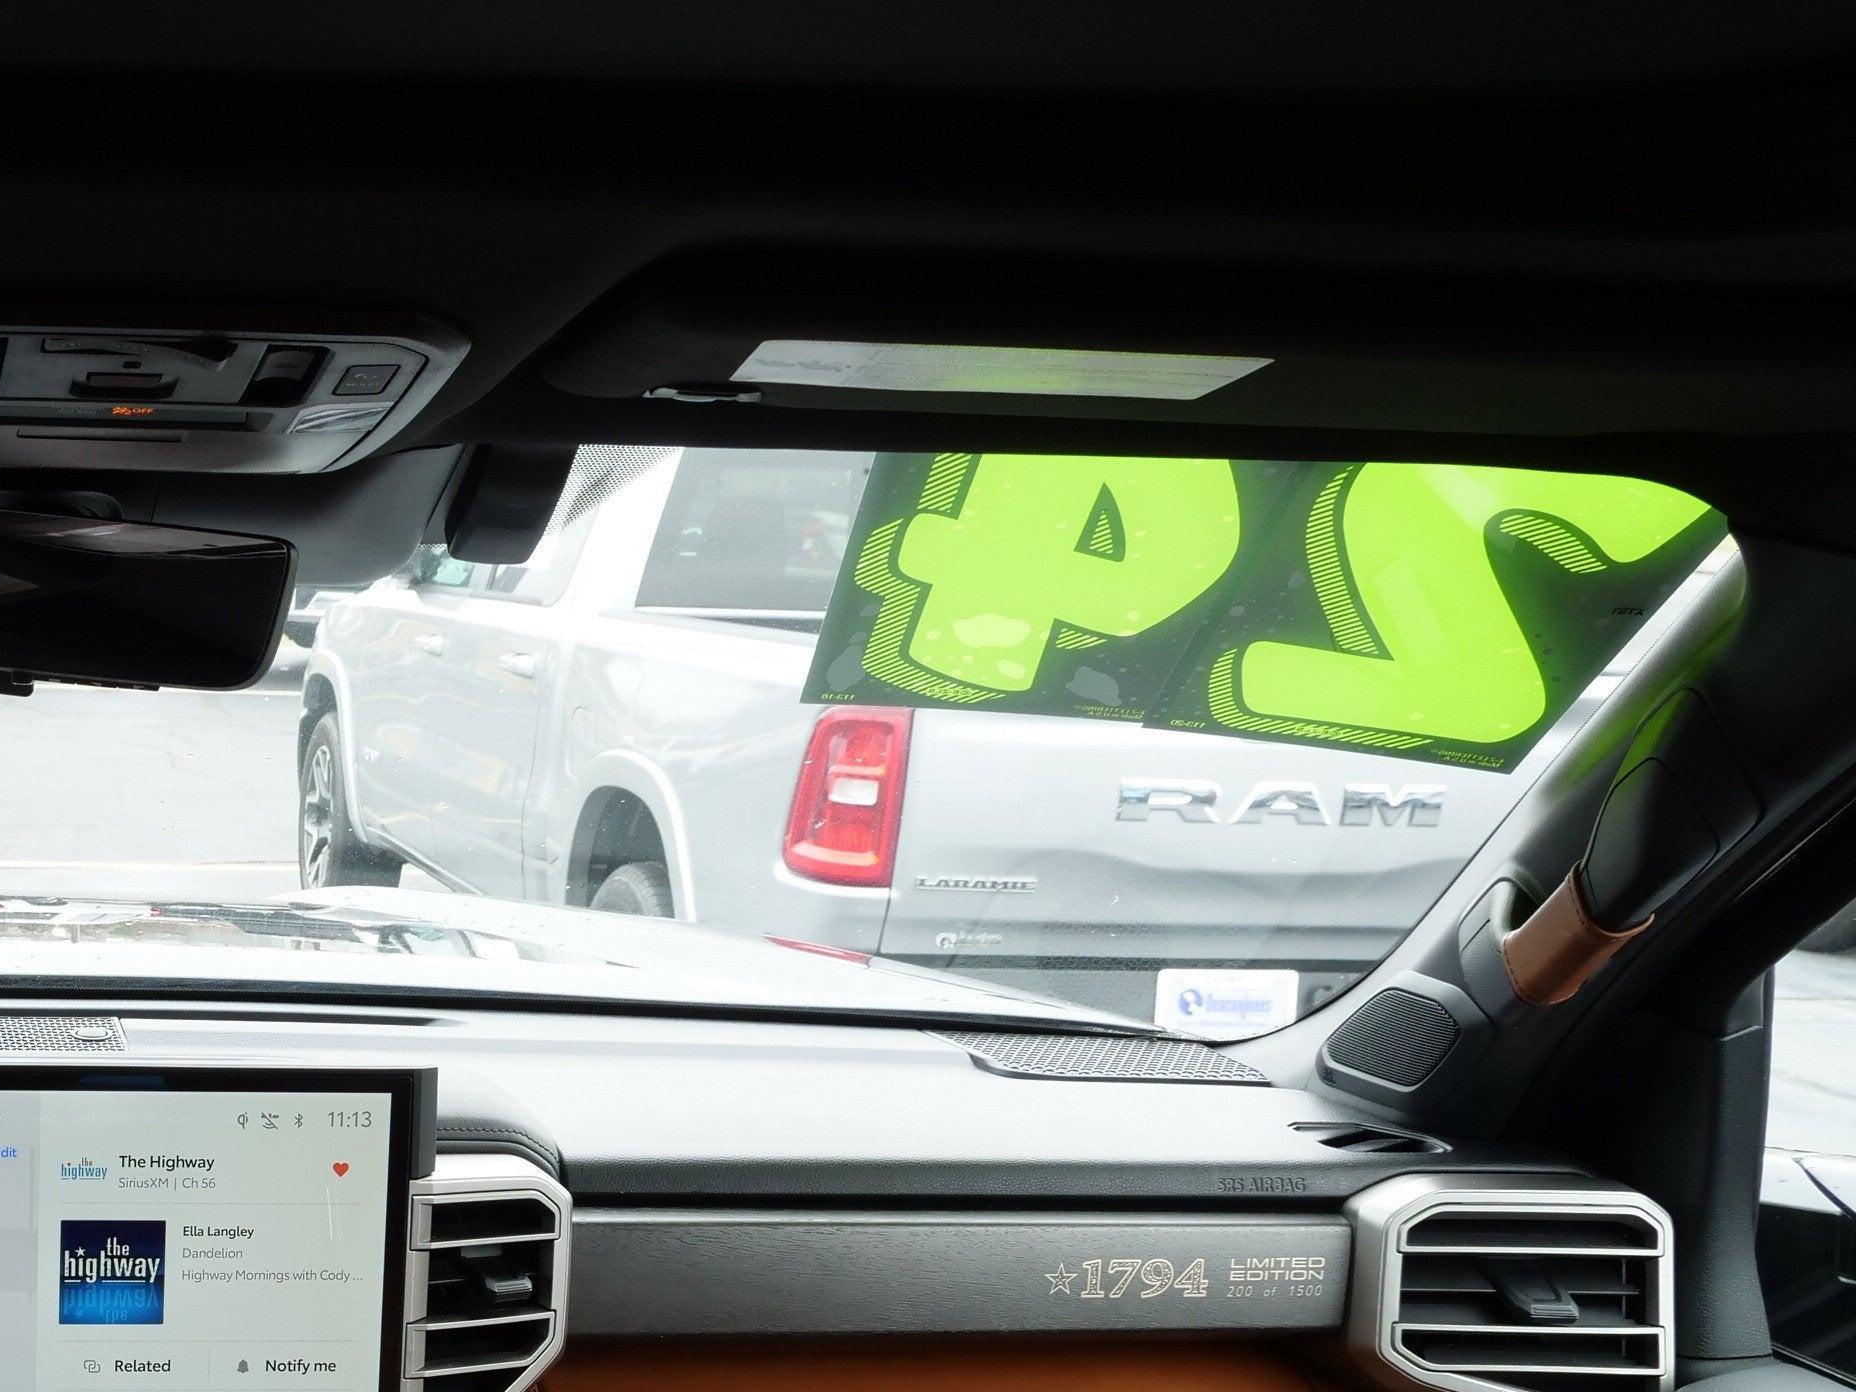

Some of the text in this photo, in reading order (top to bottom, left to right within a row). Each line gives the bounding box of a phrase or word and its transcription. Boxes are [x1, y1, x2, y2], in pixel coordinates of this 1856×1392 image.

[132, 407, 154, 415] OFF
[1115, 779, 1447, 829] RAM
[917, 877, 1037, 891] LARAMIE
[327, 1111, 372, 1128] 11:13
[119, 1155, 215, 1172] The Highway
[61, 1163, 108, 1180] highway
[118, 1177, 216, 1189] SiriusXM Ch 56
[1217, 1176, 1307, 1194] SRS AIRBAG
[183, 1226, 254, 1239] Ella Langley
[106, 1237, 130, 1256] the
[182, 1248, 243, 1259] Dandelion
[64, 1250, 160, 1283] highway
[1230, 1257, 1326, 1269] LIMITED
[182, 1270, 350, 1282] Highway Mornings with Cody
[1080, 1258, 1209, 1299] 1794
[1229, 1269, 1325, 1282] EDITION
[1227, 1284, 1323, 1298] 200 of 1500
[114, 1360, 171, 1373] Related
[265, 1360, 337, 1375] Notify me
